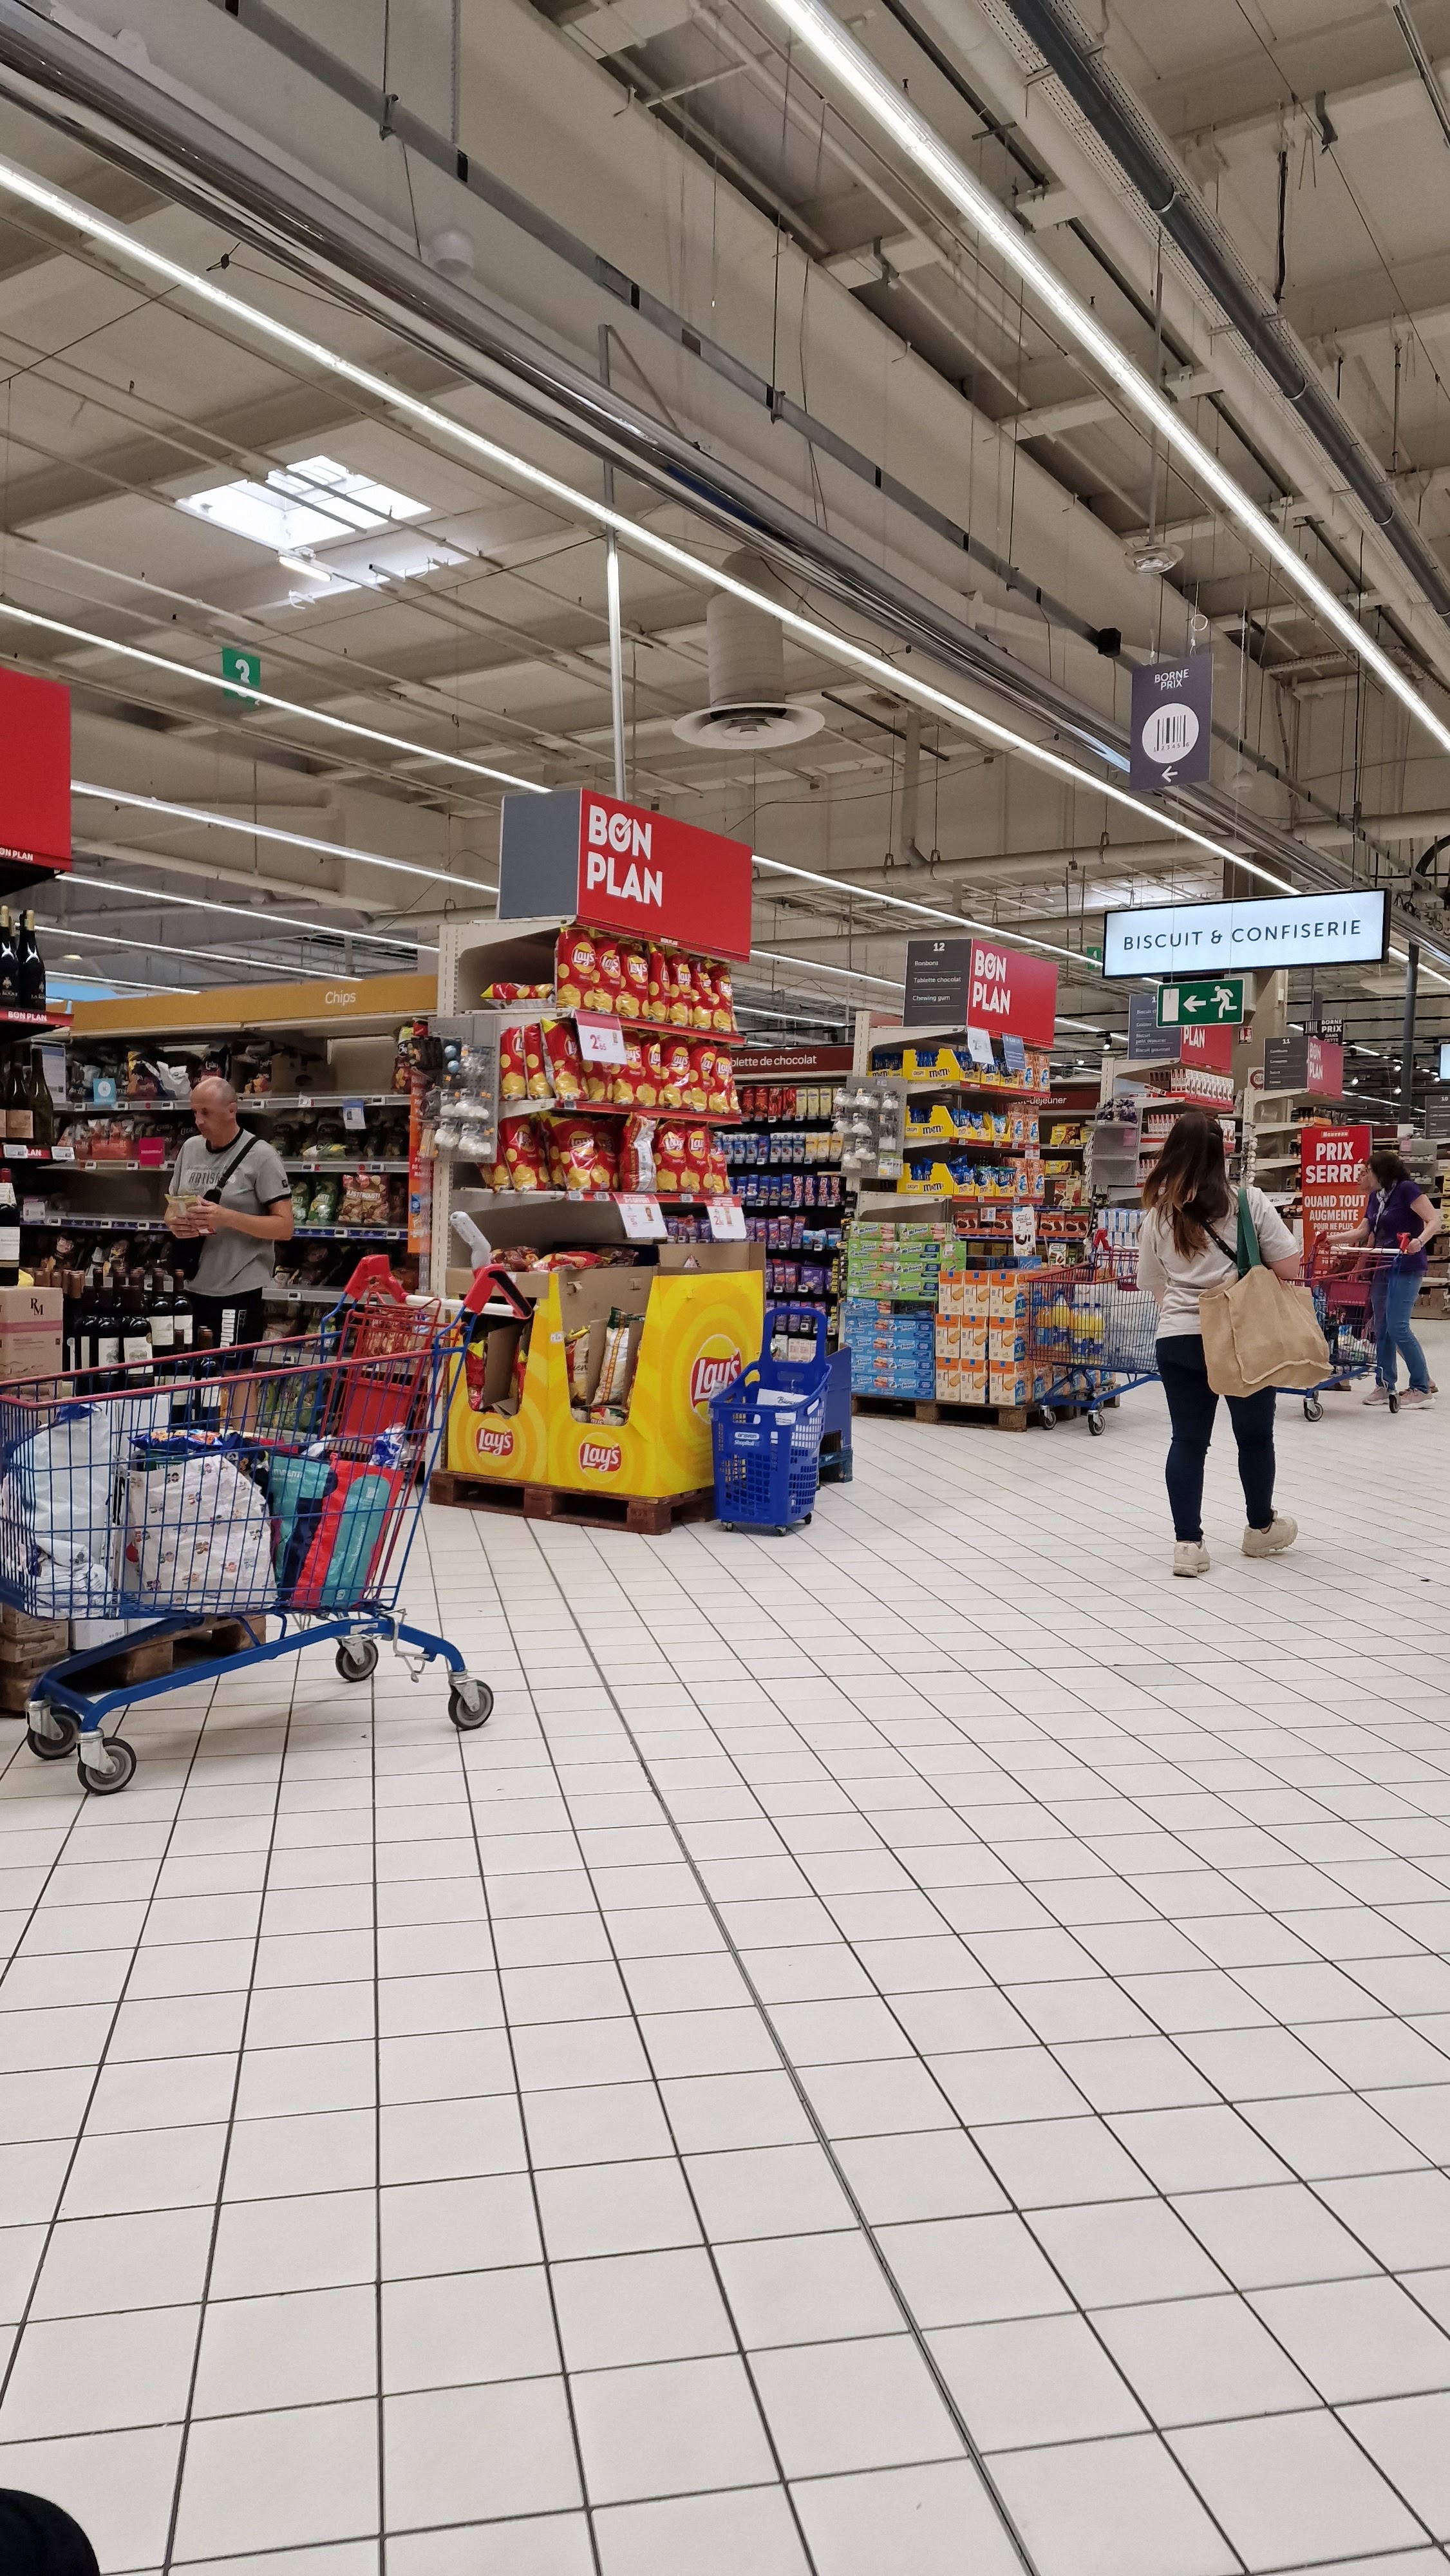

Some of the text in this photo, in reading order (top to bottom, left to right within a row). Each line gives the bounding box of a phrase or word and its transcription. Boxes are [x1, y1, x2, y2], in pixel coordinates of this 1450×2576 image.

[1154, 669, 1189, 683] BORNE
[1160, 678, 1182, 690] PRIX
[588, 804, 652, 860] BON
[0, 848, 33, 861] ON PLAN
[587, 851, 663, 907] PLAN
[1124, 920, 1361, 951] BISCUIT & CONFISERIE
[933, 942, 945, 951] 12
[572, 949, 595, 967] Lay's
[974, 949, 1006, 983] BON
[325, 990, 356, 1006] Chips
[972, 981, 1011, 1016] PLAN
[8, 1011, 47, 1022] BON PLAN
[1183, 1025, 1205, 1049] PLAN
[626, 1048, 641, 1063] ay's
[731, 1054, 817, 1067] blette de chocolat
[1309, 1061, 1323, 1080] PLAN
[1315, 1141, 1354, 1161] PRIX
[1305, 1158, 1364, 1184] SERRÉ
[1304, 1195, 1366, 1208] QUAND TOUT
[1309, 1209, 1359, 1221] AUGMENTE
[694, 1354, 740, 1400] Lay's
[478, 1428, 512, 1456] Lay's
[583, 1444, 619, 1472] Lay's
